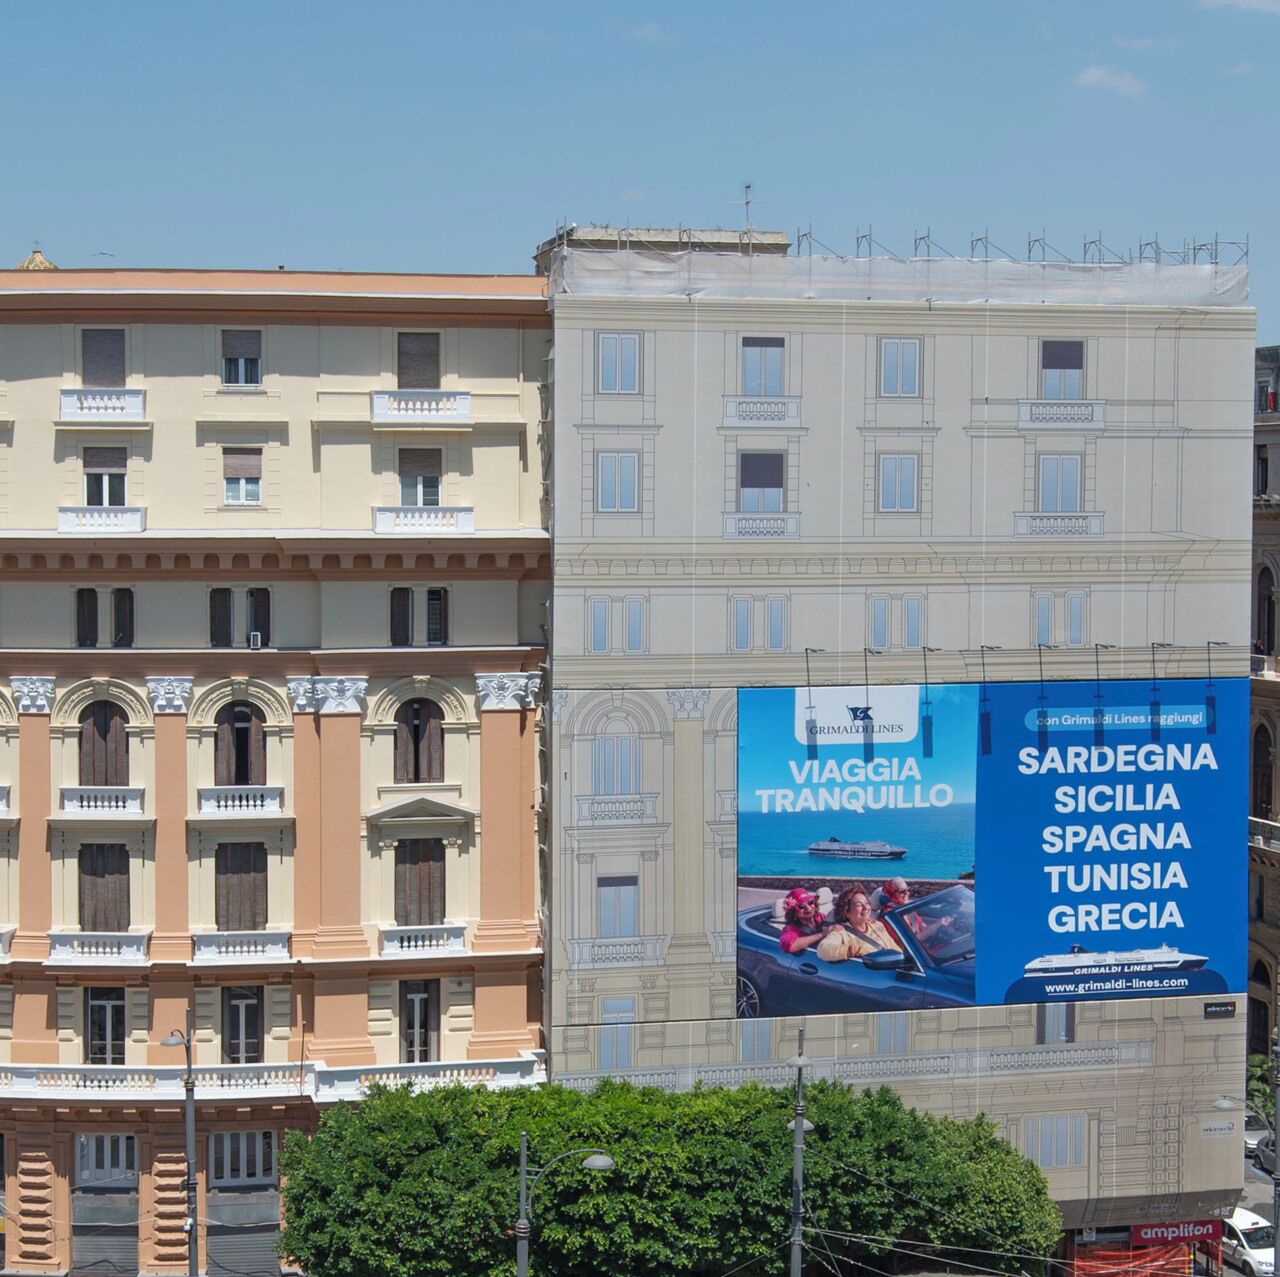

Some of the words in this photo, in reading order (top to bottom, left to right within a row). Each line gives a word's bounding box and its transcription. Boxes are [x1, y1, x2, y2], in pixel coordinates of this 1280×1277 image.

[809, 724, 869, 735] GRIMALDI
[870, 723, 904, 733] LINES
[1036, 716, 1059, 726] con
[1061, 714, 1112, 725] Grimaldi
[1114, 713, 1145, 724] Lines
[1148, 711, 1203, 726] raggiungi
[788, 757, 922, 784] VIAGGIA
[1018, 743, 1219, 775] SARDEGNA
[755, 783, 954, 813] TRANQUILLO
[1054, 783, 1181, 814] SICILIA
[1041, 822, 1192, 854] SPAGNA
[1043, 862, 1189, 893] TUNISIA
[1047, 901, 1185, 933] GRECIA
[1074, 965, 1122, 975] GRIMALDI
[1124, 964, 1154, 973] LINES
[1045, 978, 1189, 993] www.grimaldi-lines.com
[1140, 1223, 1213, 1241] amplifon
